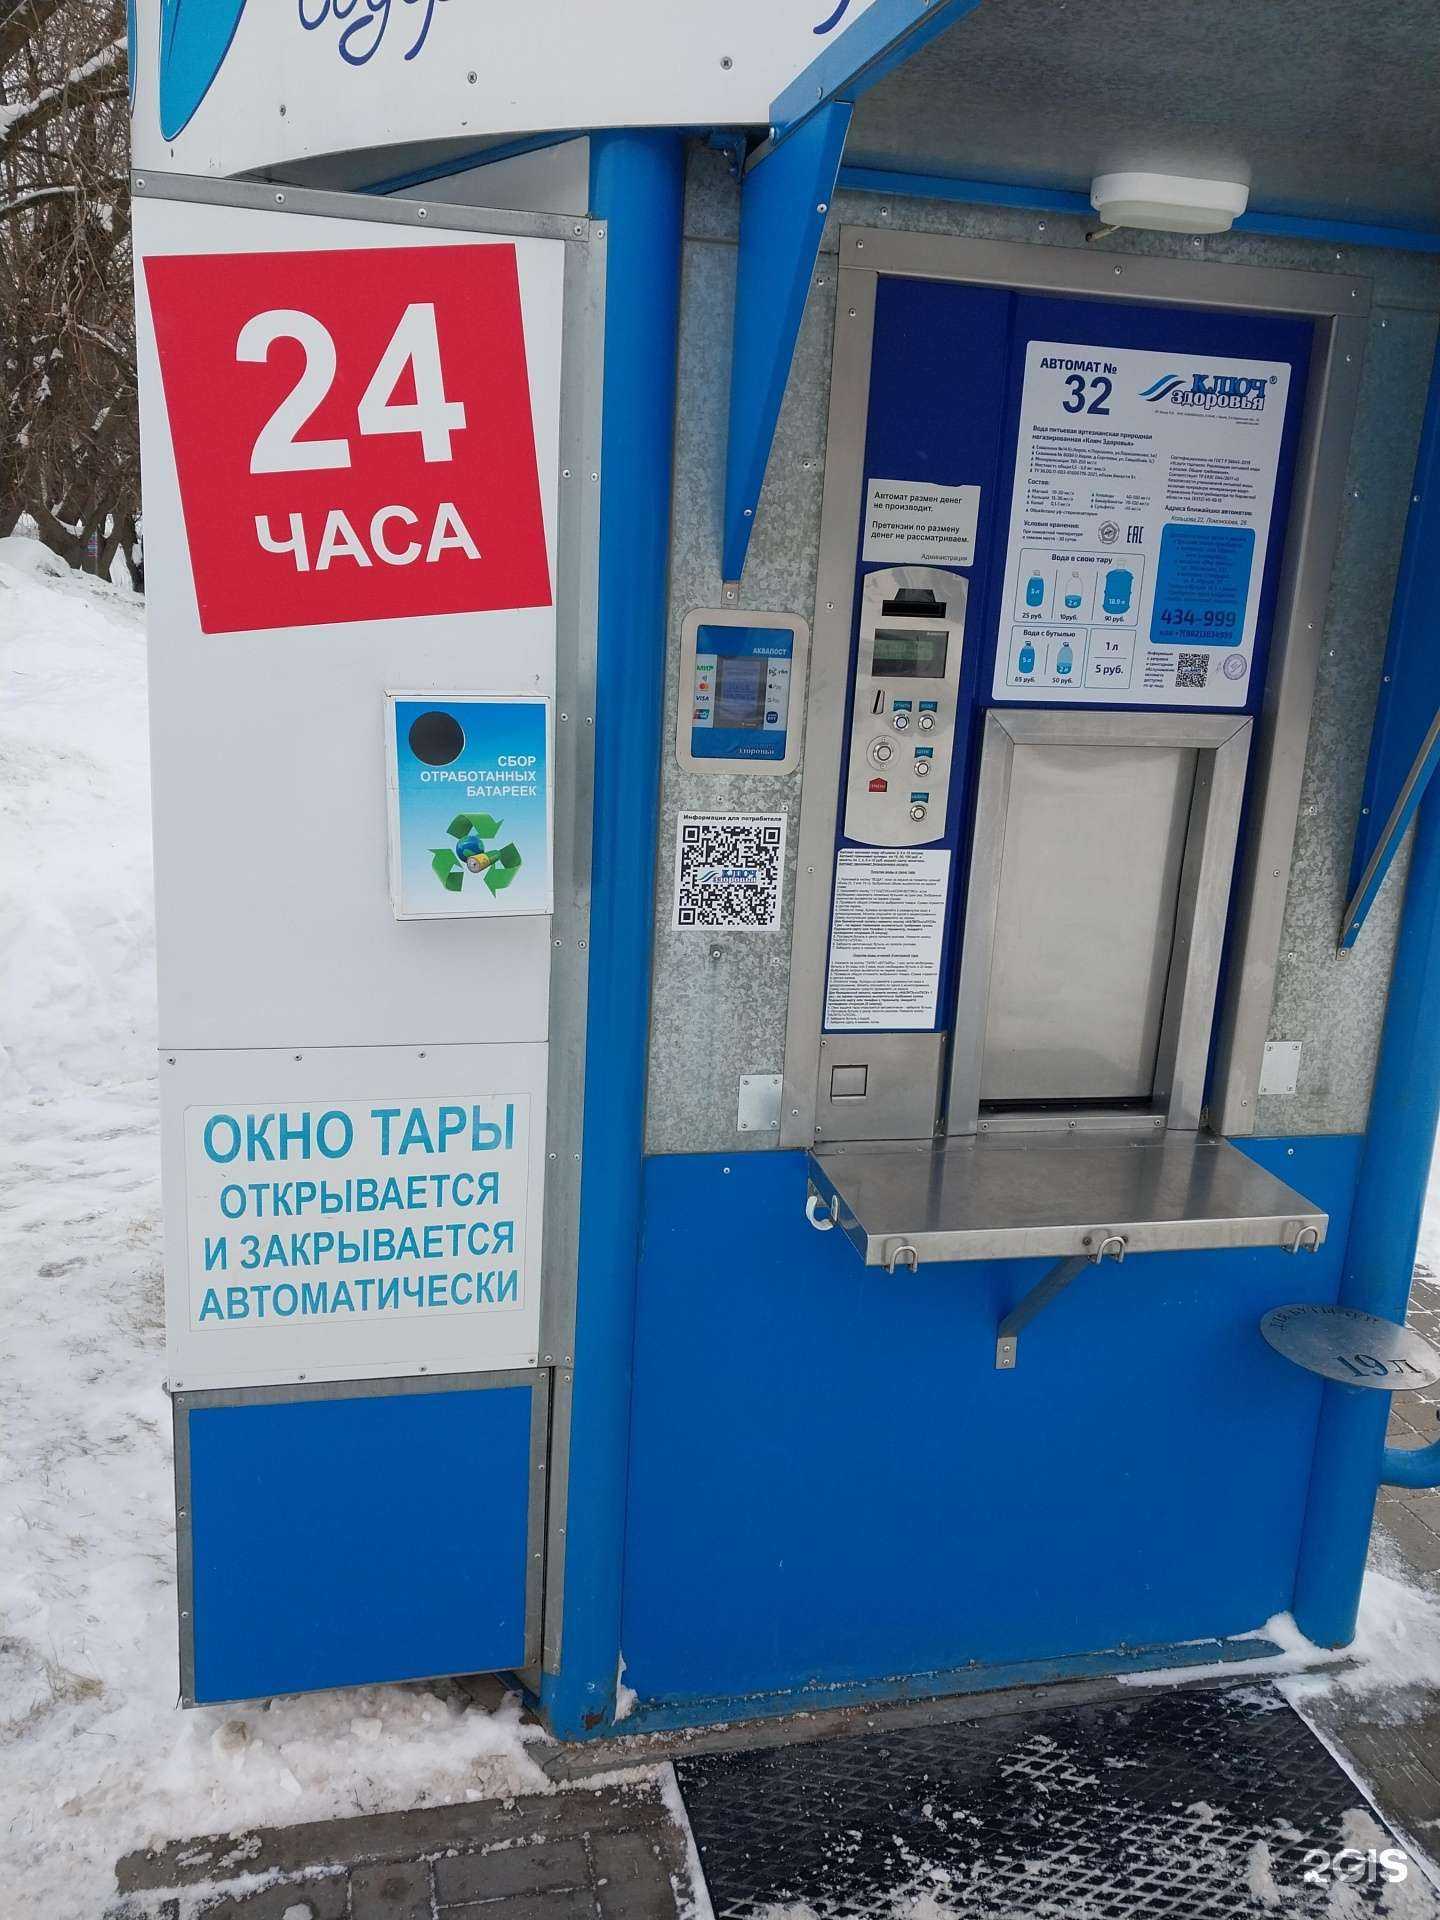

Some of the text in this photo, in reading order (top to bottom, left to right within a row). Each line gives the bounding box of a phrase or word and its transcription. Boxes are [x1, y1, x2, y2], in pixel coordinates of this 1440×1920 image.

[1040, 358, 1118, 375] АВТОМАТ №
[236, 302, 467, 475] 24
[1190, 373, 1268, 397] КЛЮЧ
[1062, 373, 1114, 416] 32
[874, 491, 963, 504] Автомат размен денег
[885, 503, 934, 513] производит.
[872, 520, 914, 531] Претензии
[927, 525, 960, 535] размену
[254, 502, 482, 572] ЧАСА
[870, 531, 894, 540] денег
[906, 533, 969, 543] рассматриваем.
[1051, 553, 1069, 562] Вода
[1096, 557, 1113, 565] тару
[1160, 607, 1237, 628] 434-999
[1023, 629, 1040, 637] Вода
[1045, 630, 1076, 638] бутылью
[752, 647, 787, 656] АКВАПОСТ
[1105, 642, 1119, 651] 1 л
[1095, 664, 1124, 677] 5 руб.
[497, 755, 537, 767] СБОР
[420, 770, 537, 783] ОТРАБОТАННЫХ
[466, 785, 537, 798] БАТАРЕЕК
[683, 814, 727, 822] Информация
[203, 1103, 514, 1164] ОКНО ТАРЫ
[219, 1171, 500, 1219] ОТКРЫВАЕТСЯ
[204, 1220, 515, 1271] И ЗАКРЫВАЕТСЯ
[198, 1269, 518, 1322] АВТОМАТИЧЕСКИ
[1334, 1353, 1390, 1377] 19
